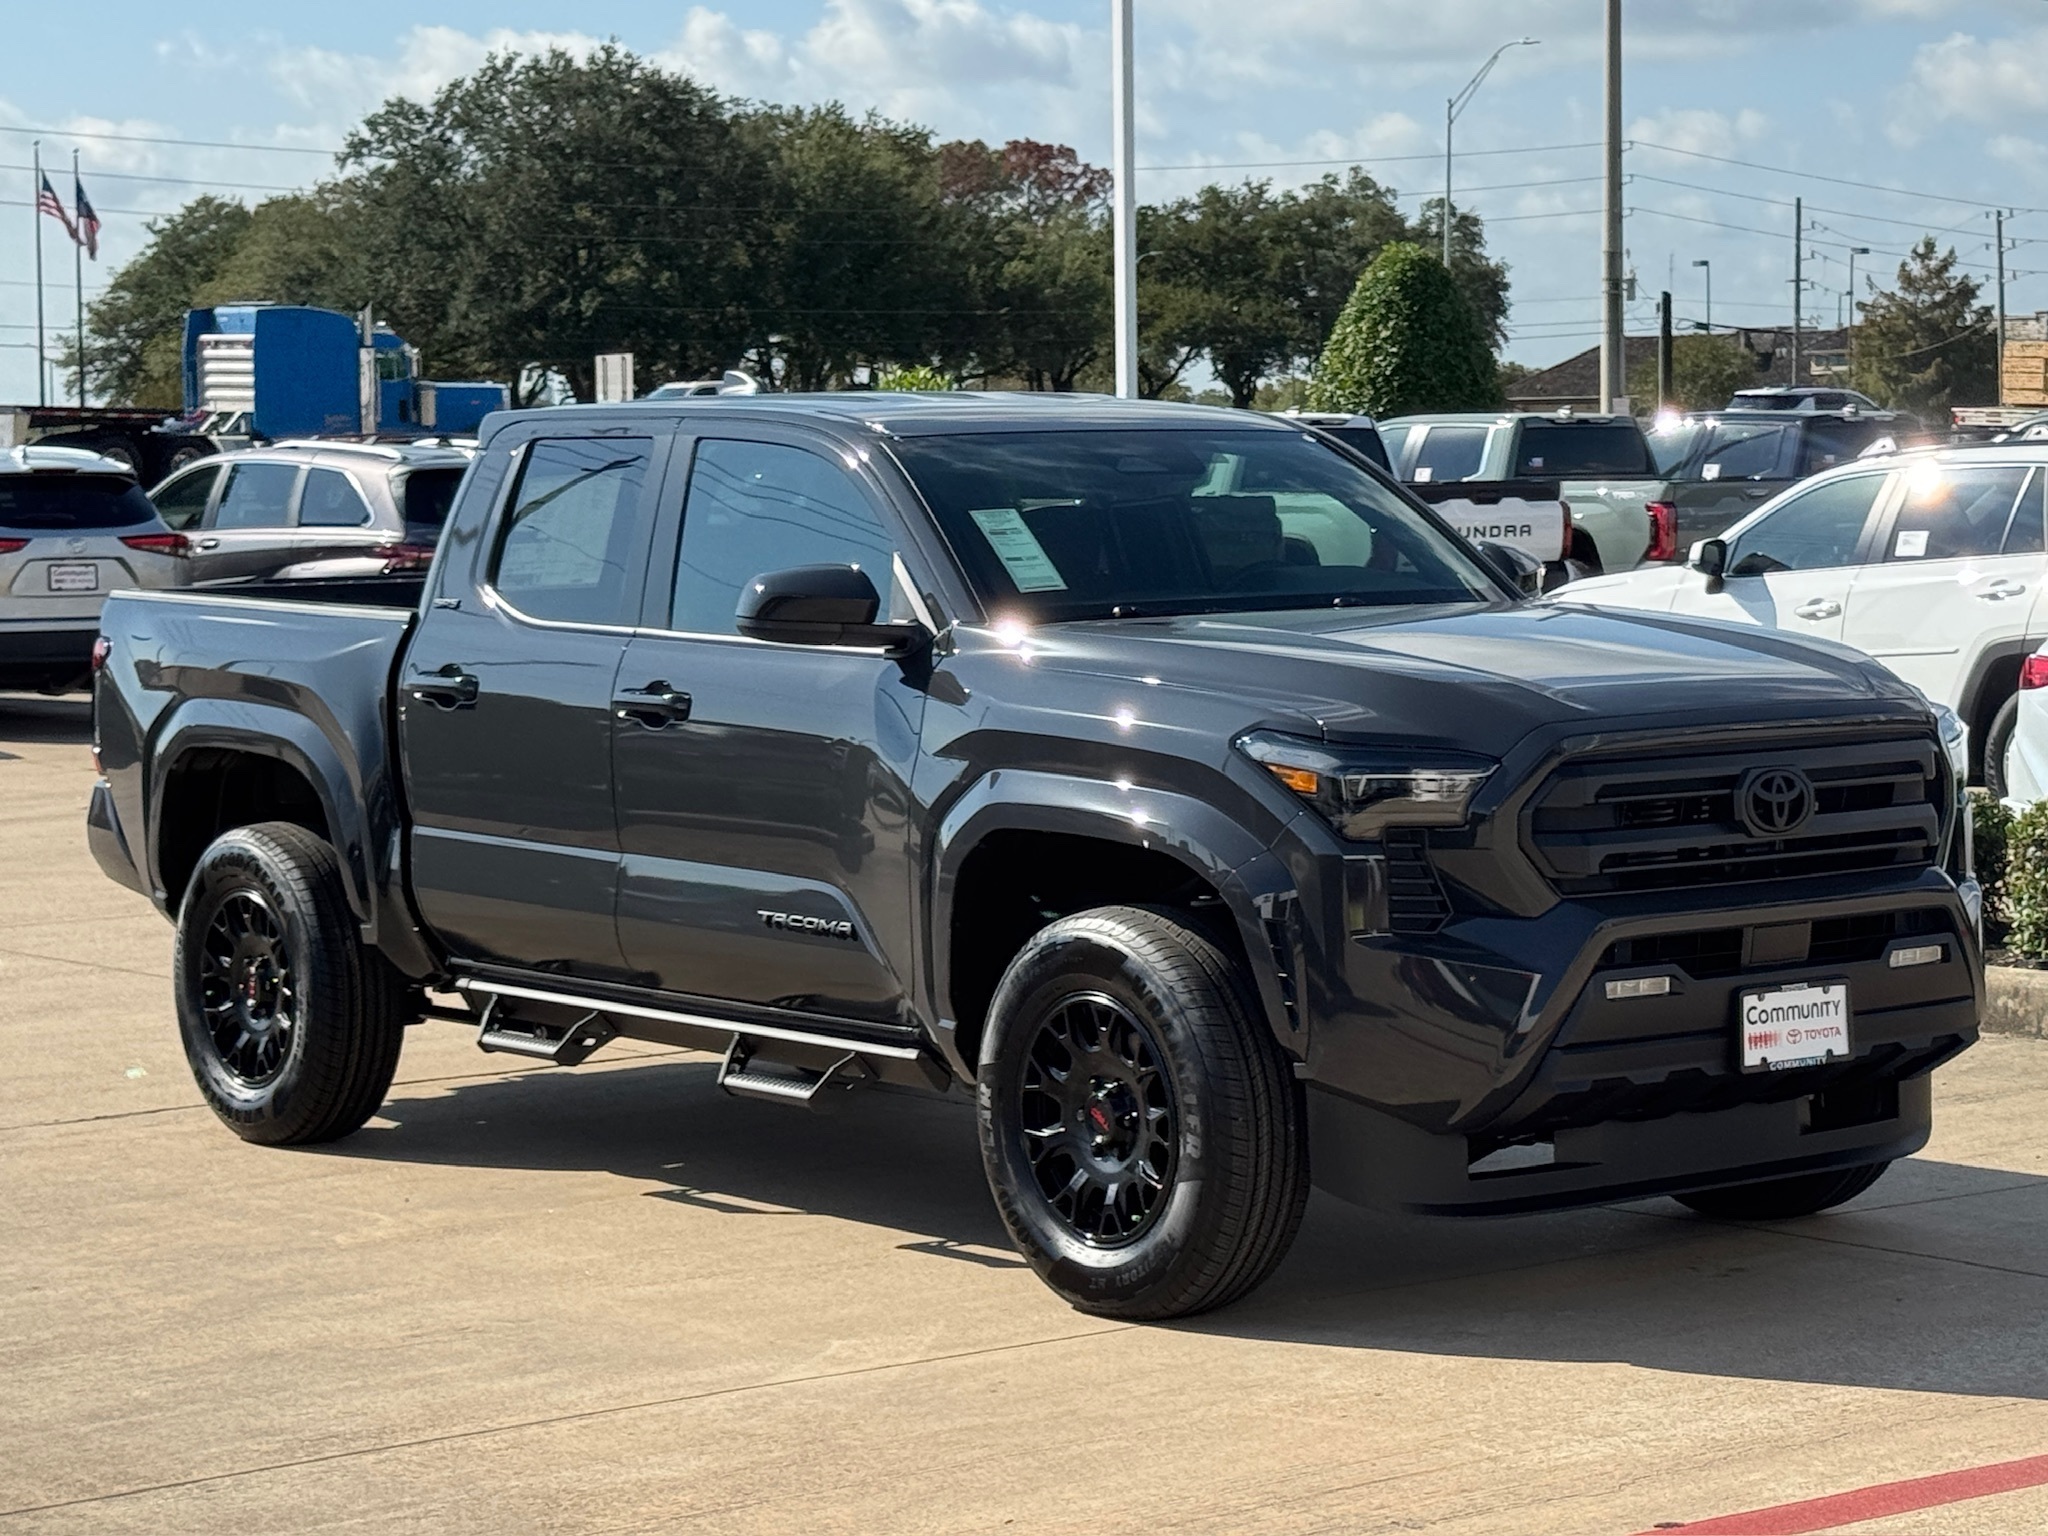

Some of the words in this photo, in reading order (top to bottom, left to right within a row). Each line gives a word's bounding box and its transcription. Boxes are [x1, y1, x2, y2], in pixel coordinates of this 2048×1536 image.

[1458, 524, 1531, 538] UNDRA
[757, 910, 854, 937] TACOMA
[1804, 1026, 1842, 1041] TOYOTA
[1769, 1056, 1827, 1071] COMMUNITY
